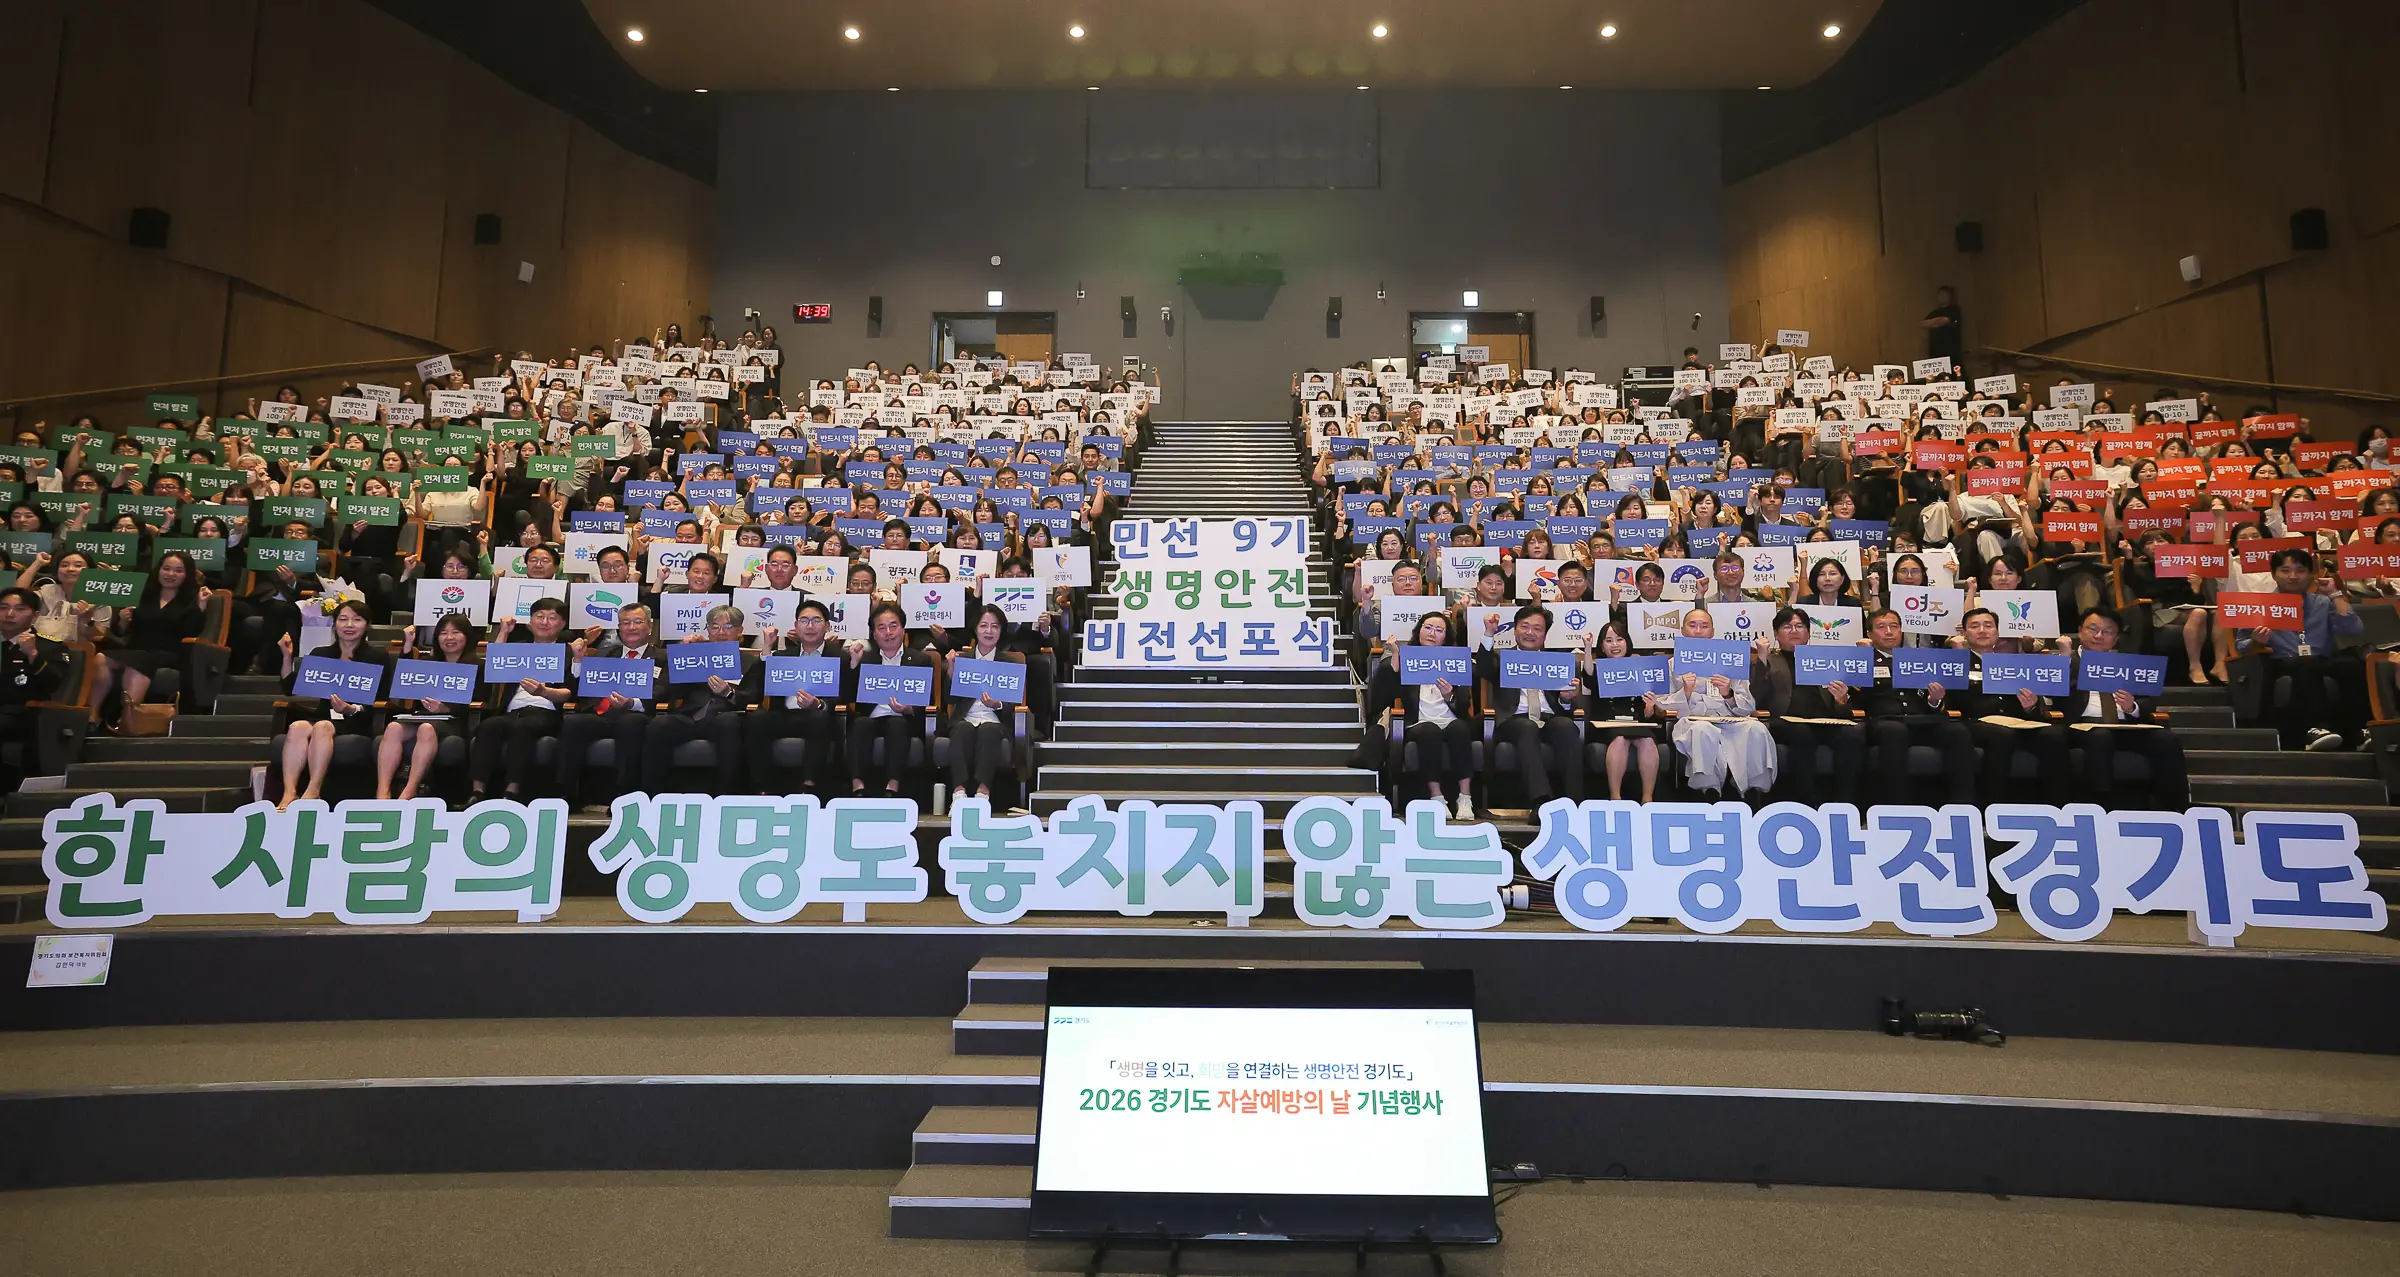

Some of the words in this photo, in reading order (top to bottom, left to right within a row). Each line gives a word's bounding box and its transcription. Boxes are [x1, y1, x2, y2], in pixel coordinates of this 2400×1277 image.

[799, 306, 828, 316] 14:39
[172, 404, 188, 412] 발견
[342, 401, 367, 409] 생명안전
[621, 404, 644, 415] 생명안전
[2195, 430, 2219, 439] 끝까지
[2220, 429, 2235, 437] 함께
[1680, 448, 1701, 456] 반드시
[1921, 452, 1945, 462] 끝까지
[1948, 454, 1964, 462] 함께
[552, 464, 567, 472] 발견
[761, 464, 775, 472] 연결
[1337, 466, 1358, 475] 반드시
[1360, 466, 1374, 475] 연결
[424, 475, 440, 483] 먼저
[443, 475, 460, 483] 발견
[1972, 478, 1998, 487] 끝까지
[2002, 477, 2020, 486] 함께
[690, 490, 714, 498] 반드시
[717, 489, 732, 497] 연결
[273, 506, 291, 516] 먼저
[295, 507, 314, 517] 발견
[348, 505, 367, 514] 먼저
[370, 506, 389, 516] 발견
[2292, 511, 2326, 522] 끝까지
[2330, 510, 2353, 520] 함께
[575, 521, 600, 530] 반드시
[604, 521, 620, 530] 연결
[2048, 522, 2076, 532] 끝까지
[2079, 522, 2097, 532] 함께
[2128, 519, 2158, 529] 끝까지
[2162, 518, 2182, 528] 함께
[1619, 529, 1644, 538] 반드시
[1647, 528, 1664, 537] 연결
[1835, 530, 1862, 539] 반드시
[1866, 530, 1883, 540] 연결
[1113, 520, 1199, 560] 민선
[1233, 519, 1305, 554] 9기
[76, 543, 98, 553] 먼저
[102, 544, 125, 554] 발견
[259, 549, 279, 559] 먼저
[283, 550, 305, 561] 발견
[2160, 555, 2197, 567] 끝까지
[2200, 556, 2224, 566] 함께
[888, 566, 917, 577] 광주시
[1457, 570, 1478, 578] 남양주
[802, 575, 834, 584] 이천시
[1752, 573, 1776, 582] 성남시
[86, 581, 107, 592] 먼저
[110, 583, 132, 595] 발견
[1112, 568, 1306, 610] 생명안전
[432, 607, 471, 618] 구리시
[1003, 603, 1027, 612] 경기도
[1904, 594, 1949, 622] 여주
[2224, 604, 2265, 616] 끝까지
[2270, 605, 2297, 618] 함께
[677, 609, 702, 619] PAJU
[914, 611, 952, 621] 용인특례시
[1905, 618, 1930, 627] YEOJU
[2008, 622, 2035, 631] 과천시
[1650, 633, 1675, 641] 김포시
[1823, 631, 1840, 640] 오산
[1087, 620, 1329, 663] 비전선포식
[493, 657, 530, 669] 반드시
[535, 657, 558, 669] 연결
[674, 656, 708, 670] 반드시
[712, 655, 734, 668] 연결
[1680, 650, 1716, 664] 반드시
[1721, 653, 1743, 666] 연결
[1407, 659, 1441, 671] 반드시
[1445, 660, 1466, 672] 연결
[1507, 663, 1541, 676] 반드시
[1546, 665, 1568, 678] 연결
[1802, 659, 1839, 671] 반드시
[1844, 660, 1867, 673] 연결
[1900, 662, 1936, 674] 반드시
[1941, 663, 1963, 676] 연결
[586, 671, 620, 684] 반드시
[625, 672, 647, 685] 연결
[772, 670, 806, 682] 반드시
[811, 671, 833, 683] 연결
[1604, 670, 1638, 684] 반드시
[1642, 669, 1664, 682] 연결
[1989, 668, 2029, 680] 반드시
[2035, 669, 2062, 682] 연결
[2087, 665, 2129, 680] 반드시
[2134, 669, 2158, 682] 연결
[305, 670, 344, 686] 반드시
[348, 676, 373, 690] 연결
[401, 673, 438, 687] 반드시
[444, 676, 468, 690] 연결
[865, 678, 899, 690] 반드시
[904, 680, 925, 693] 연결
[959, 671, 993, 686] 반드시
[998, 676, 1019, 689] 연결
[55, 803, 165, 917] 한
[212, 809, 557, 914] 사람의
[599, 802, 917, 912] 생명도
[949, 804, 1253, 913] 놓치지
[1293, 807, 1502, 918] 않는
[1533, 808, 1984, 923] 생명안전
[1996, 815, 2373, 929] 경기도
[1162, 1062, 1194, 1079] 잇고,
[1244, 1063, 1299, 1080] 연결하는
[1304, 1063, 1359, 1081] 생명안전
[1079, 1088, 1142, 1111] 2026
[1148, 1088, 1212, 1114] 경기도
[1217, 1089, 1323, 1115] 자살예방의
[1330, 1089, 1351, 1114] 날
[1357, 1089, 1444, 1115] 기념행사
